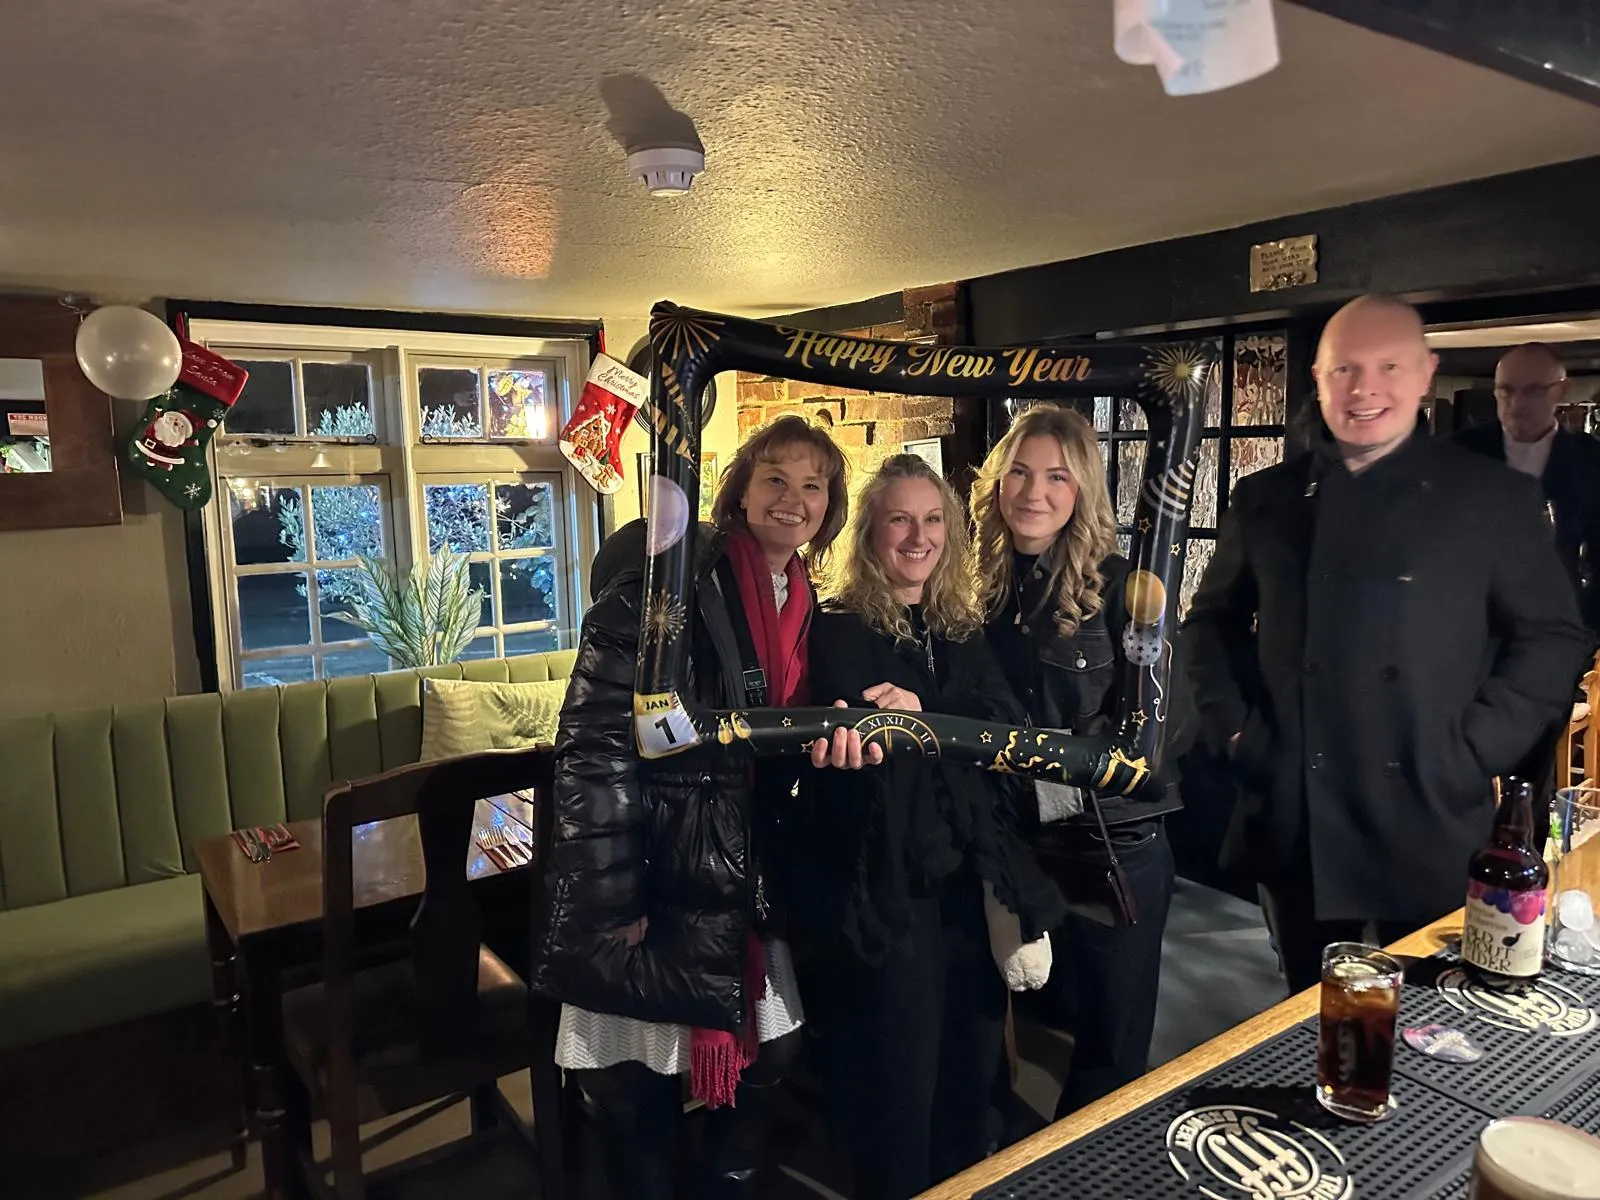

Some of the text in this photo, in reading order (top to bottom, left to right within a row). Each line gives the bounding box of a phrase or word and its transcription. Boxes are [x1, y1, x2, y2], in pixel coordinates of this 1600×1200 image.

[776, 324, 1092, 387] Happy New Year
[597, 372, 641, 399] Christmas
[607, 366, 638, 389] Merry
[646, 699, 670, 710] JAN
[654, 716, 677, 745] 1
[868, 717, 882, 729] XI
[886, 716, 904, 726] XII
[1467, 924, 1493, 944] OLD
[1465, 946, 1512, 973] CIDER
[1466, 938, 1516, 959] MOUT
[1284, 1173, 1342, 1200] TRIP
